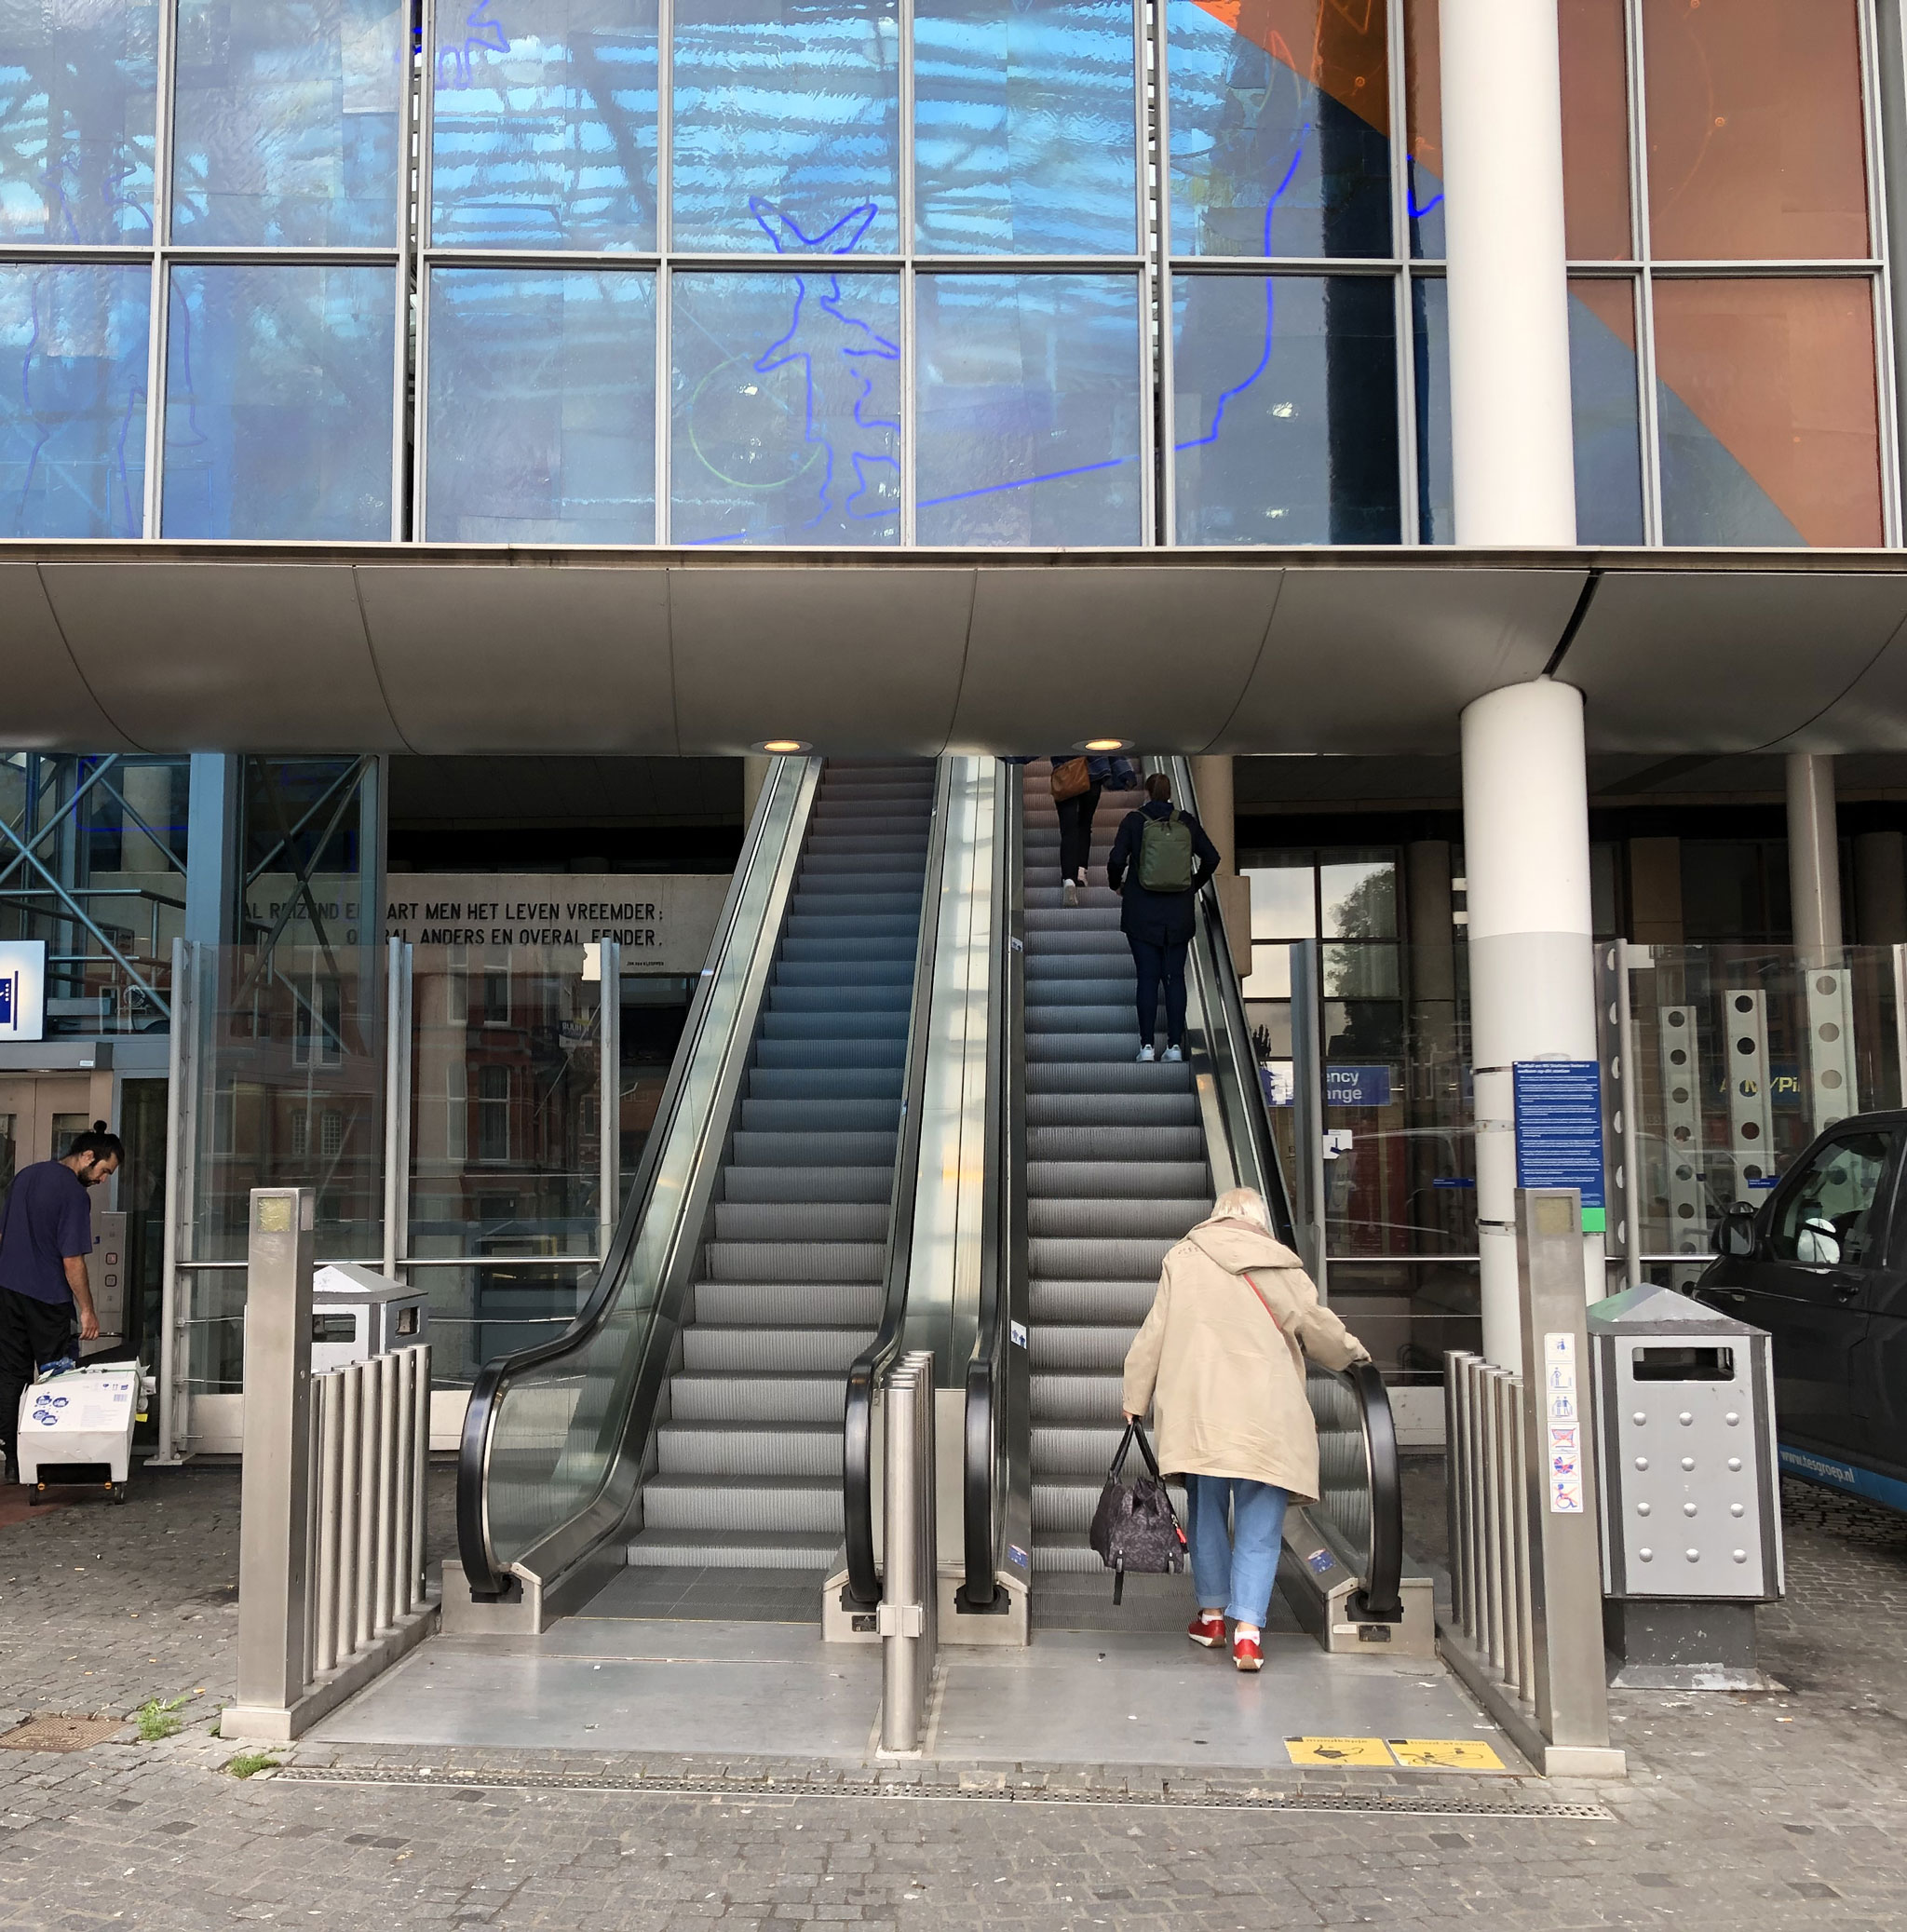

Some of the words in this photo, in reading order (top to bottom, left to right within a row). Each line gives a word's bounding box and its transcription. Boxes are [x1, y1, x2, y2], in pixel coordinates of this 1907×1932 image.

[426, 902, 461, 920] MEN
[467, 902, 499, 920] HET
[506, 902, 559, 920] LEVEN
[420, 928, 484, 944] ANDERS
[492, 928, 513, 944] EN
[520, 928, 582, 945] OVERAL
[1779, 1450, 1856, 1483] www.tesgroep.nl
